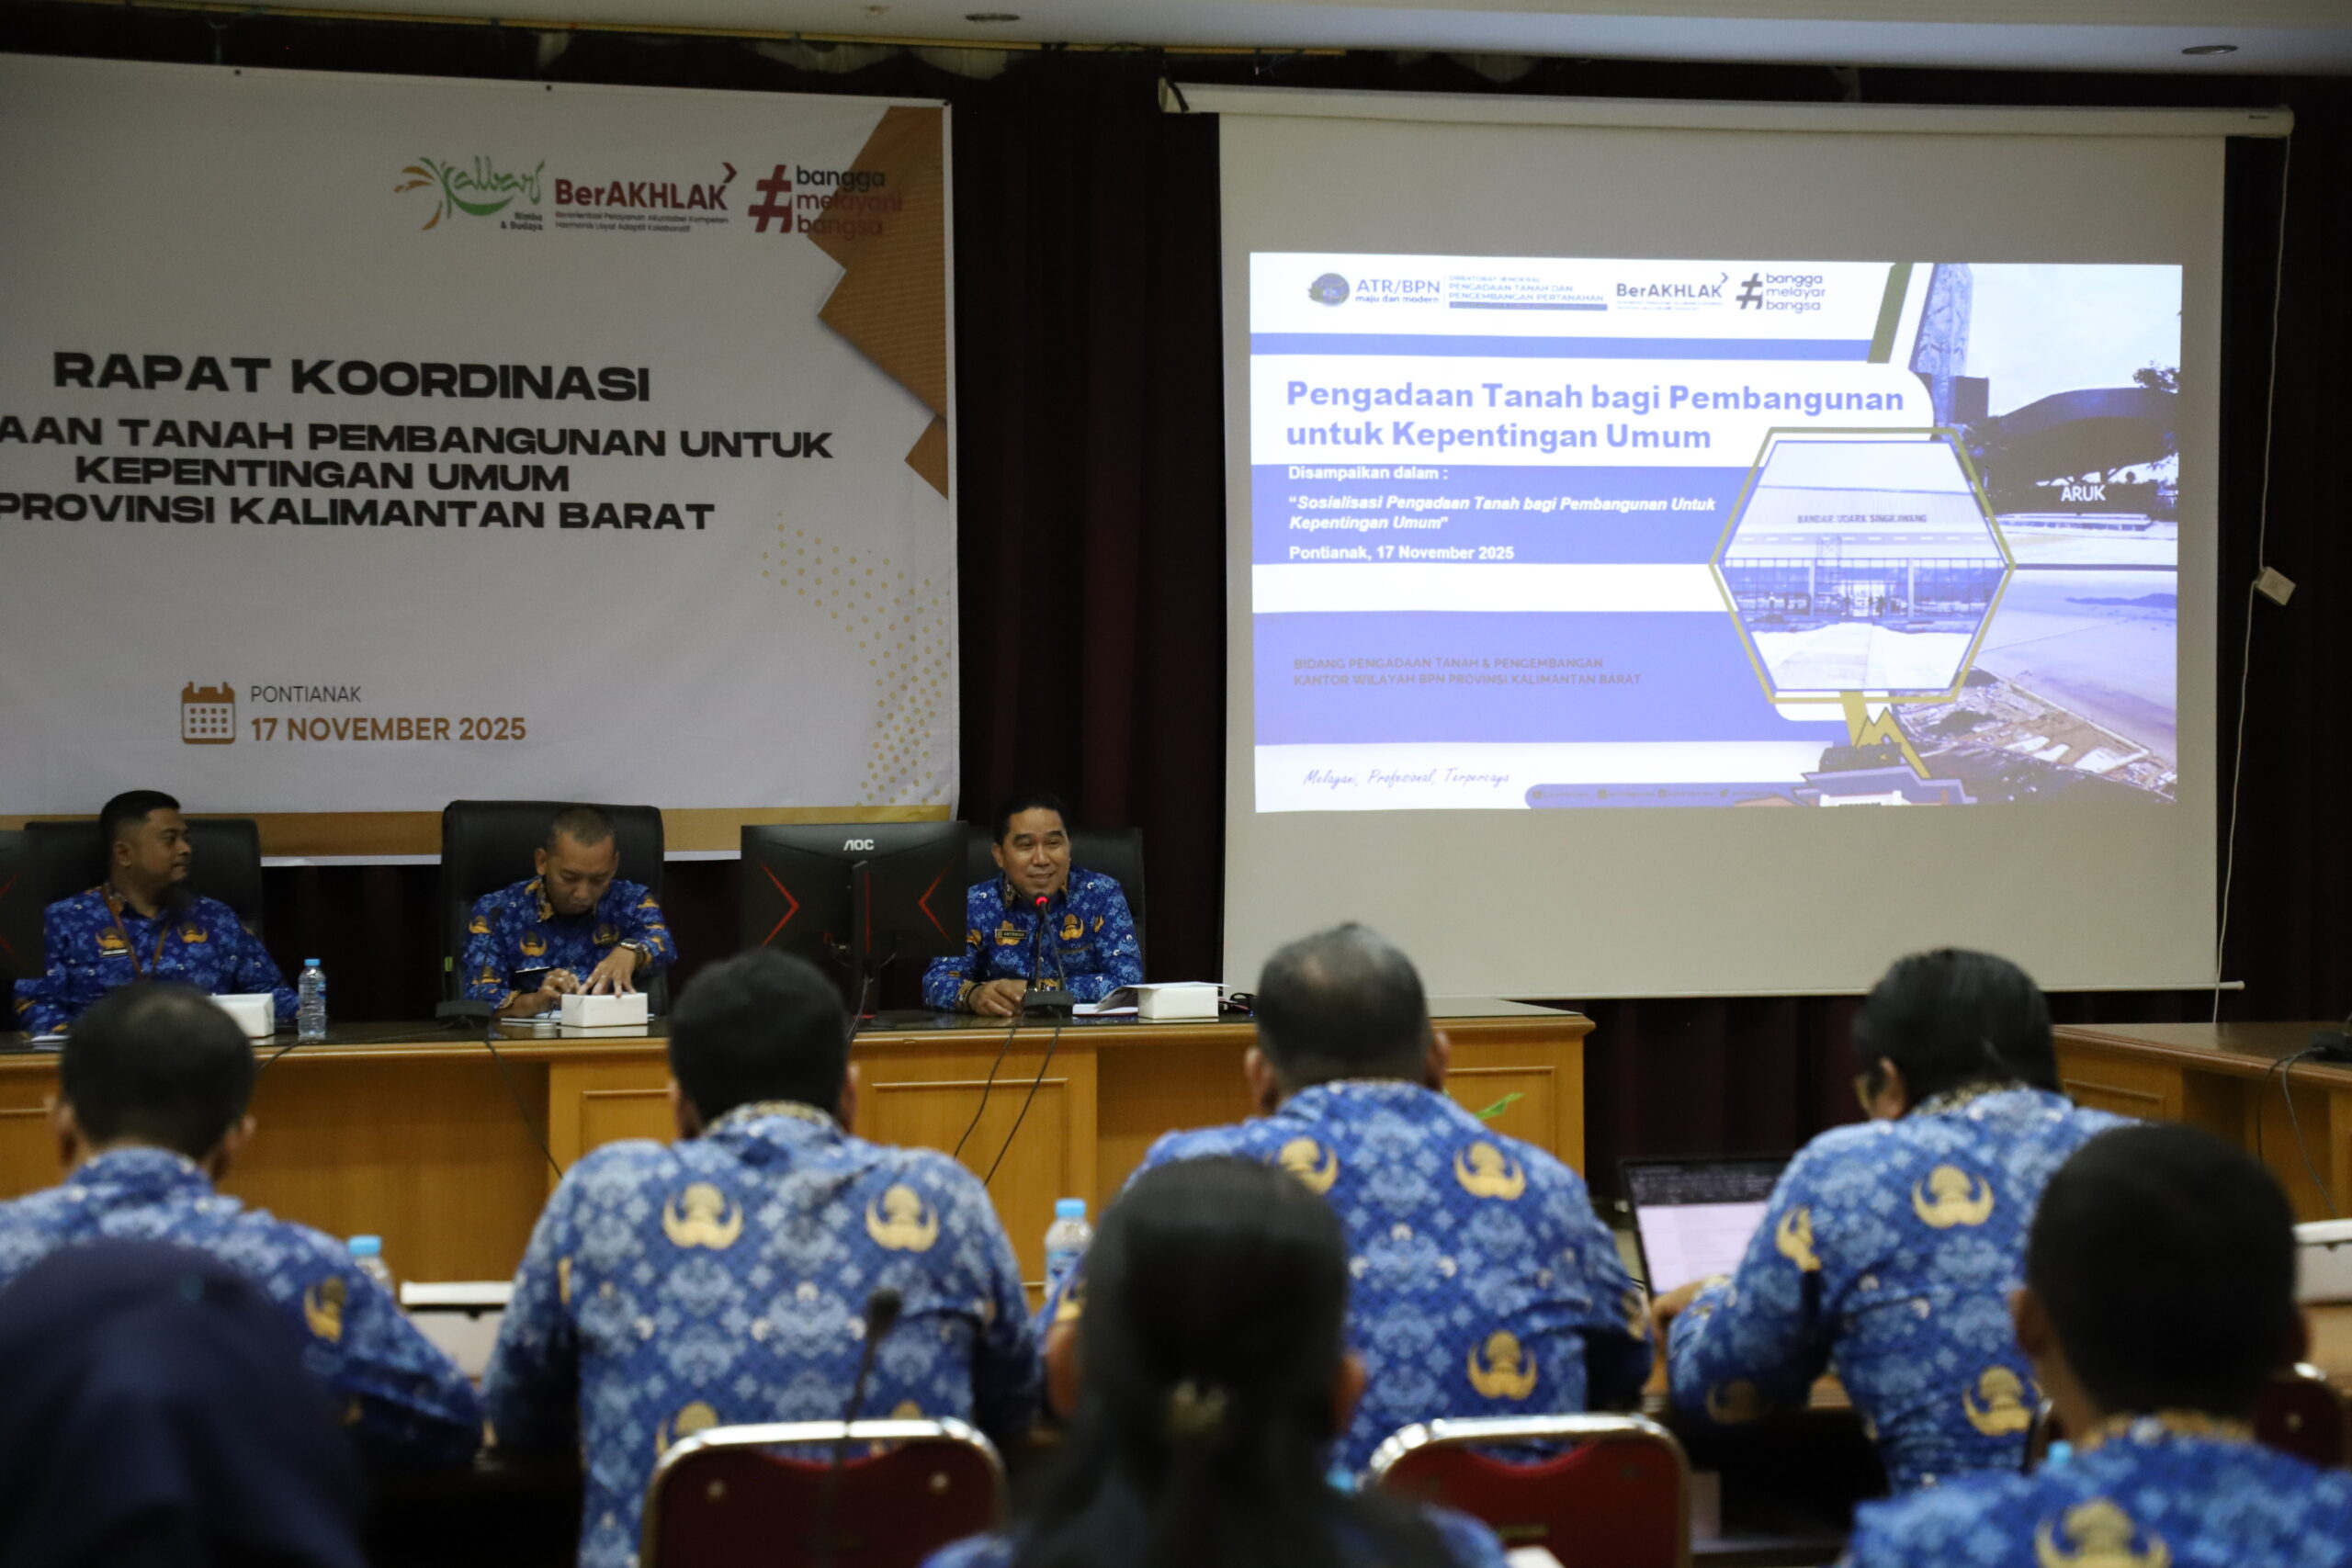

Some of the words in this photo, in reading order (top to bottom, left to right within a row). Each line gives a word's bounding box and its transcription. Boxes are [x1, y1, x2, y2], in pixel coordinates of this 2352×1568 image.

[797, 165, 885, 193] bangga
[555, 178, 728, 210] BerAKHLAK
[797, 192, 903, 216] melayani
[510, 220, 544, 231] Budaya
[797, 214, 883, 240] bangsa
[1356, 279, 1441, 294] ATR/BPN
[1449, 282, 1511, 291] PENGADAAN
[1515, 284, 1549, 292] TANAH
[1767, 272, 1823, 288] bangga
[1355, 294, 1379, 304] maju
[1382, 295, 1400, 304] dan
[1403, 295, 1440, 305] modern
[1449, 291, 1533, 300] PENGEMBANGAN
[1536, 293, 1604, 302] PERTANAHAN
[1616, 283, 1723, 299] BerAKHLAK
[1767, 299, 1821, 314] bangsa
[53, 352, 271, 393] RAPAT
[291, 358, 650, 401] KOORDINASI
[1286, 381, 1475, 411] Pengadaan
[1482, 383, 1583, 409] Tanah
[1591, 384, 1660, 413] bagi
[1668, 385, 1905, 417] Pembangunan
[118, 418, 292, 449] TANAH
[309, 423, 666, 457] PEMBANGUNAN
[680, 431, 833, 459] UNTUK
[1286, 422, 1383, 447] untuk
[1392, 422, 1598, 454] Kepentingan
[1606, 424, 1712, 449] Umum
[76, 456, 413, 490] KEPENTINGAN
[428, 464, 570, 492] UMUM
[1288, 466, 1390, 482] Disampaikan
[1394, 466, 1440, 479] dalam
[2061, 484, 2107, 502] ARUK
[0, 492, 213, 523] PROVINSI
[231, 497, 544, 528] KALIMANTAN
[560, 502, 715, 530] BARAT
[1386, 496, 1469, 513] Pengadaan
[1475, 496, 1520, 511] Tanah
[1523, 497, 1557, 514] bagi
[1560, 497, 1668, 514] Pembangunan
[1671, 497, 1716, 512] Untuk
[1289, 515, 1389, 533] Kepentingan
[1289, 546, 1372, 562] Pontianak,
[1376, 546, 1395, 559] 17
[1398, 546, 1474, 560] November
[1478, 546, 1514, 560] 2025
[1294, 658, 1347, 671] BIDANG
[1349, 658, 1432, 670] PENGADAAN
[1436, 657, 1479, 669] TANAH
[1482, 657, 1491, 670] &
[1495, 657, 1604, 670] PENGEMBANGAN
[1294, 674, 1350, 686] KANTOR
[1351, 674, 1416, 686] WILAYAH
[1419, 673, 1446, 685] BPN
[1448, 673, 1509, 685] PROVINSI
[1511, 673, 1596, 685] KALIMANTAN
[1600, 673, 1642, 685] BARAT
[251, 686, 362, 703] PONTIANAK
[251, 717, 278, 741] 17
[288, 717, 450, 741] NOVEMBER
[459, 716, 526, 741] 2025
[1443, 767, 1510, 789] Terpercaya
[843, 839, 875, 852] AOC
